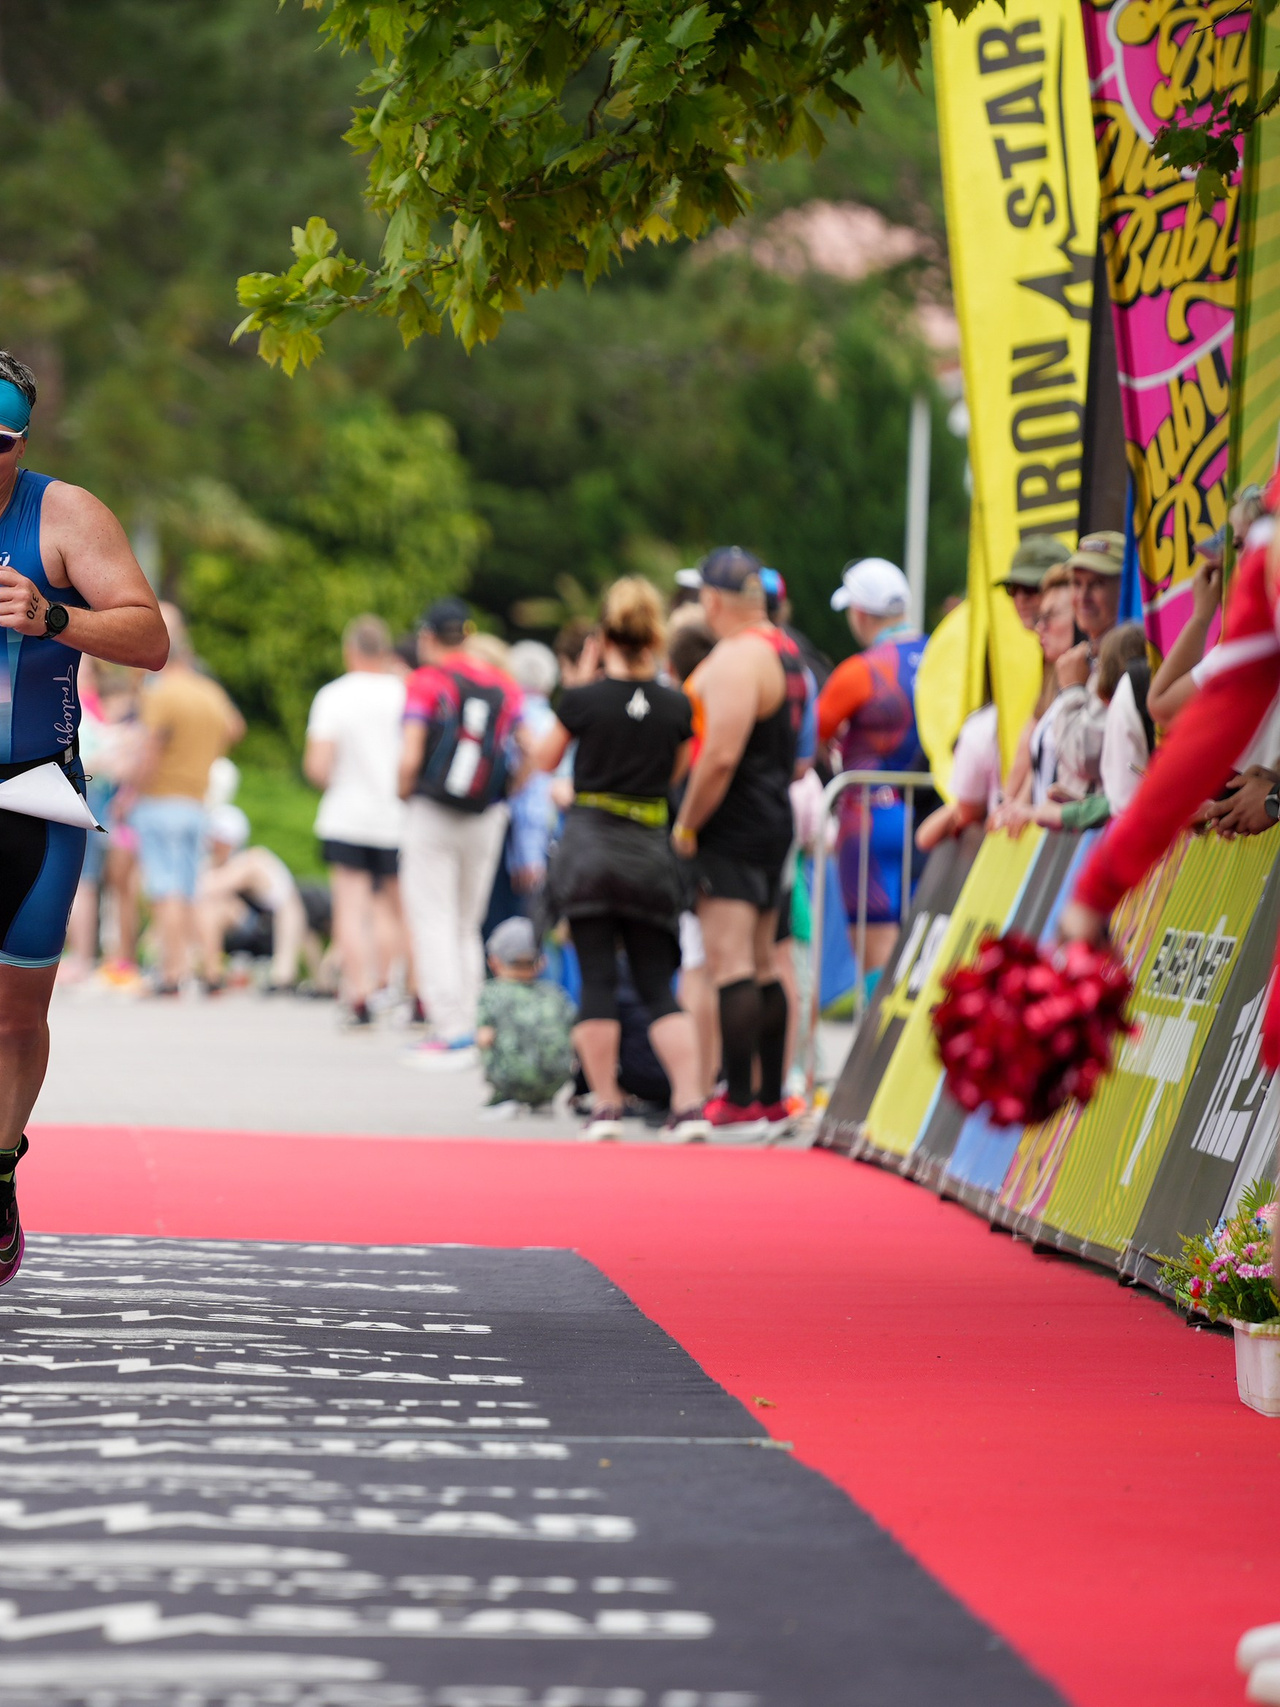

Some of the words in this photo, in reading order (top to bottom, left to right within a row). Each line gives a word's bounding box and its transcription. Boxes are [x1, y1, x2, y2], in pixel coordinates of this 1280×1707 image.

[977, 14, 1055, 230] STAR
[1010, 336, 1085, 551] IRON
[53, 665, 76, 745] Trilogy
